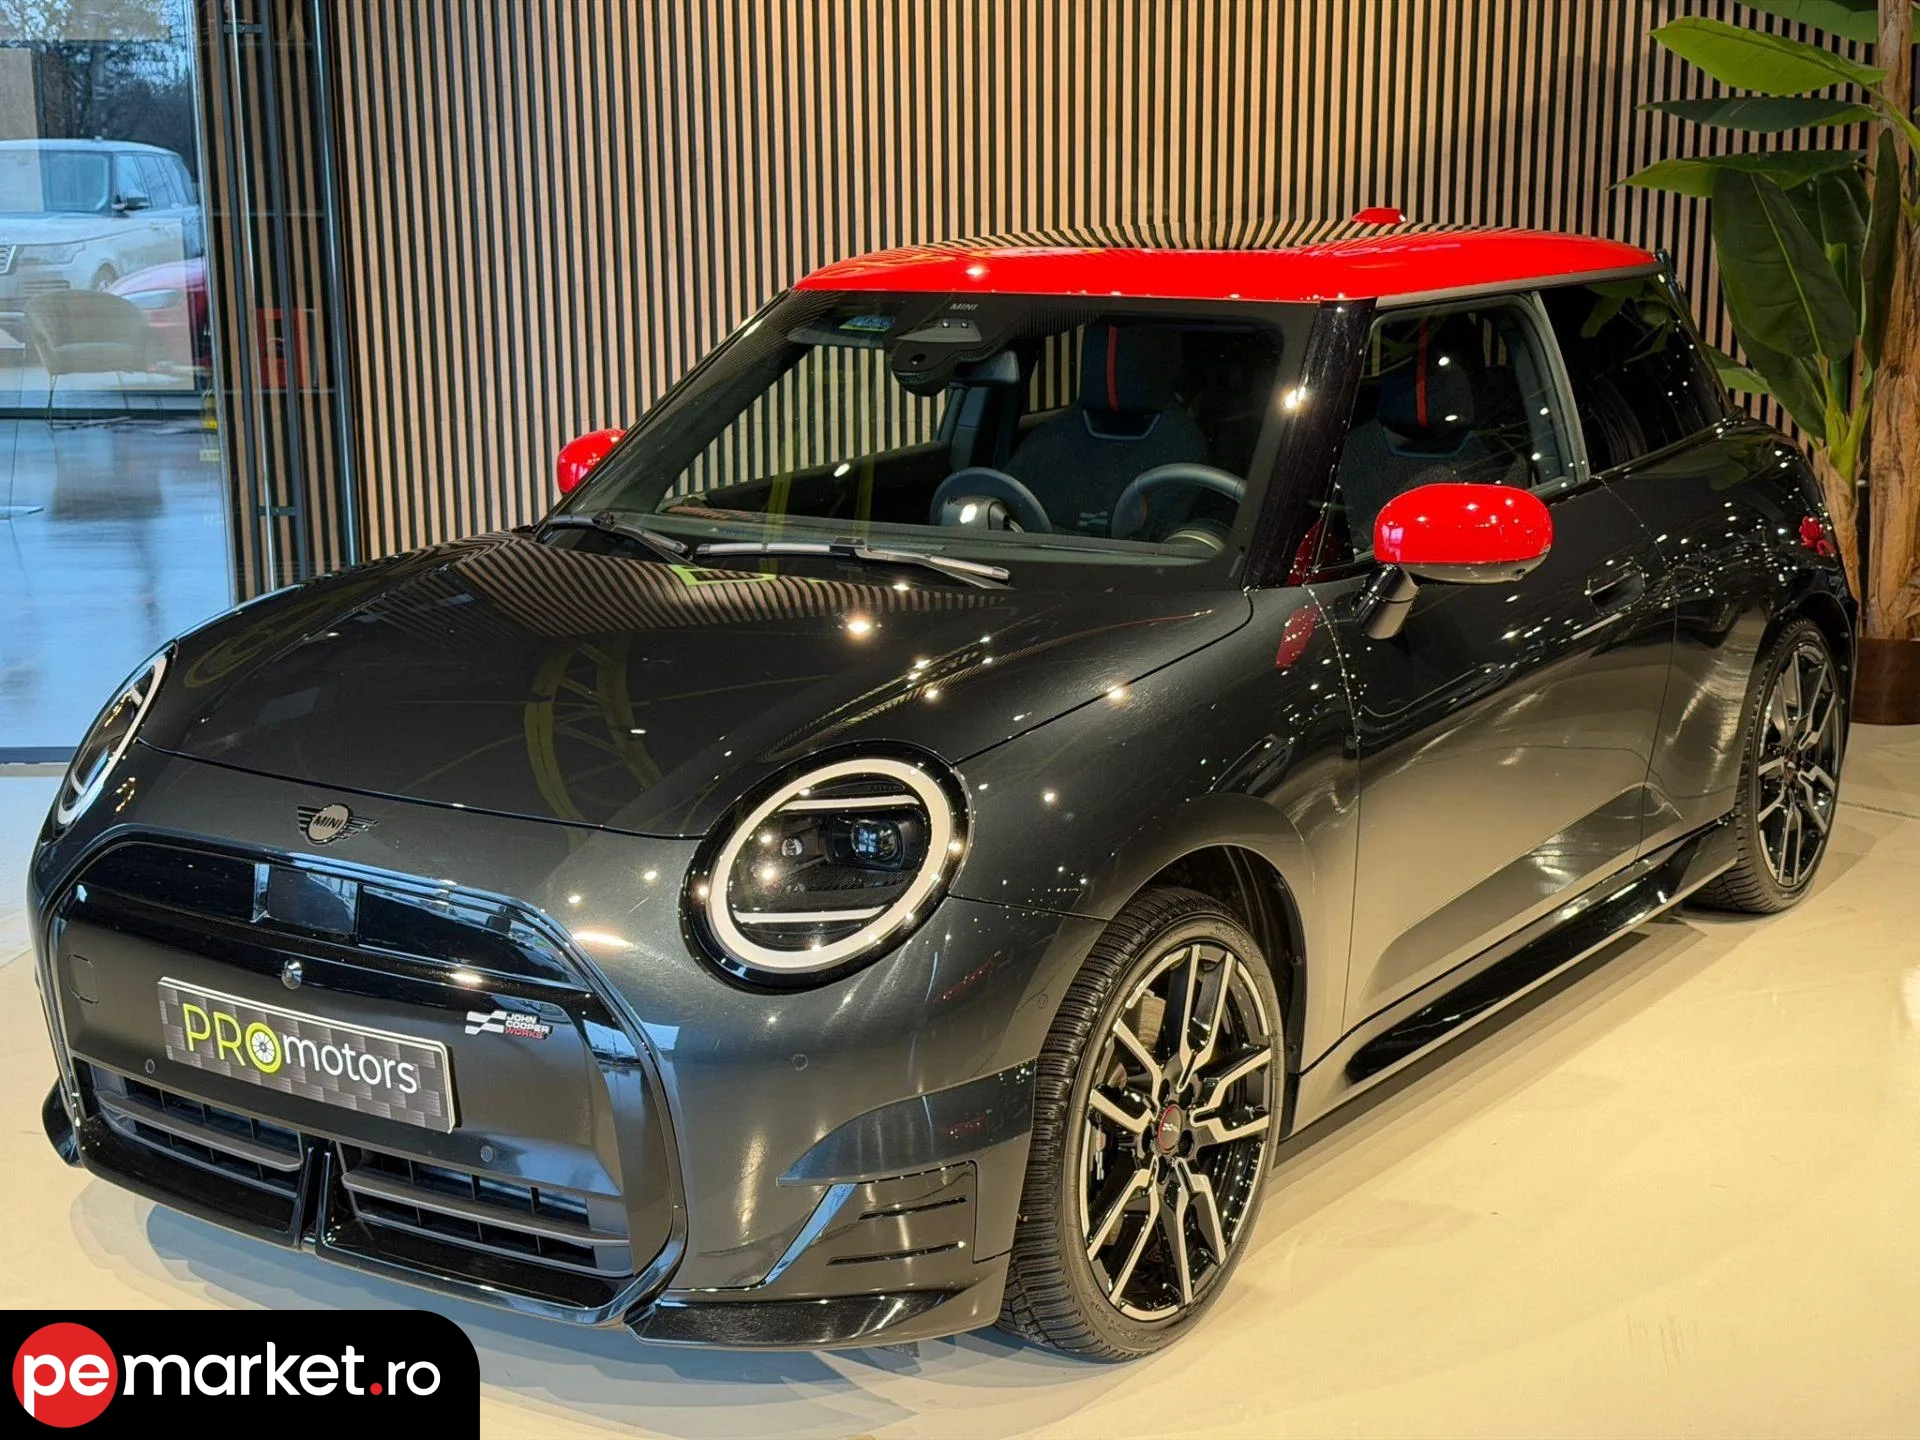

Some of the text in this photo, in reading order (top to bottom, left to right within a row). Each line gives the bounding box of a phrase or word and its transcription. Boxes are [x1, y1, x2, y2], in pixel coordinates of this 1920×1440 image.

[950, 303, 978, 311] MINI
[313, 815, 344, 830] MINI
[506, 1013, 538, 1024] JOHN
[505, 1020, 550, 1034] COOPER
[505, 1026, 544, 1040] WORKS
